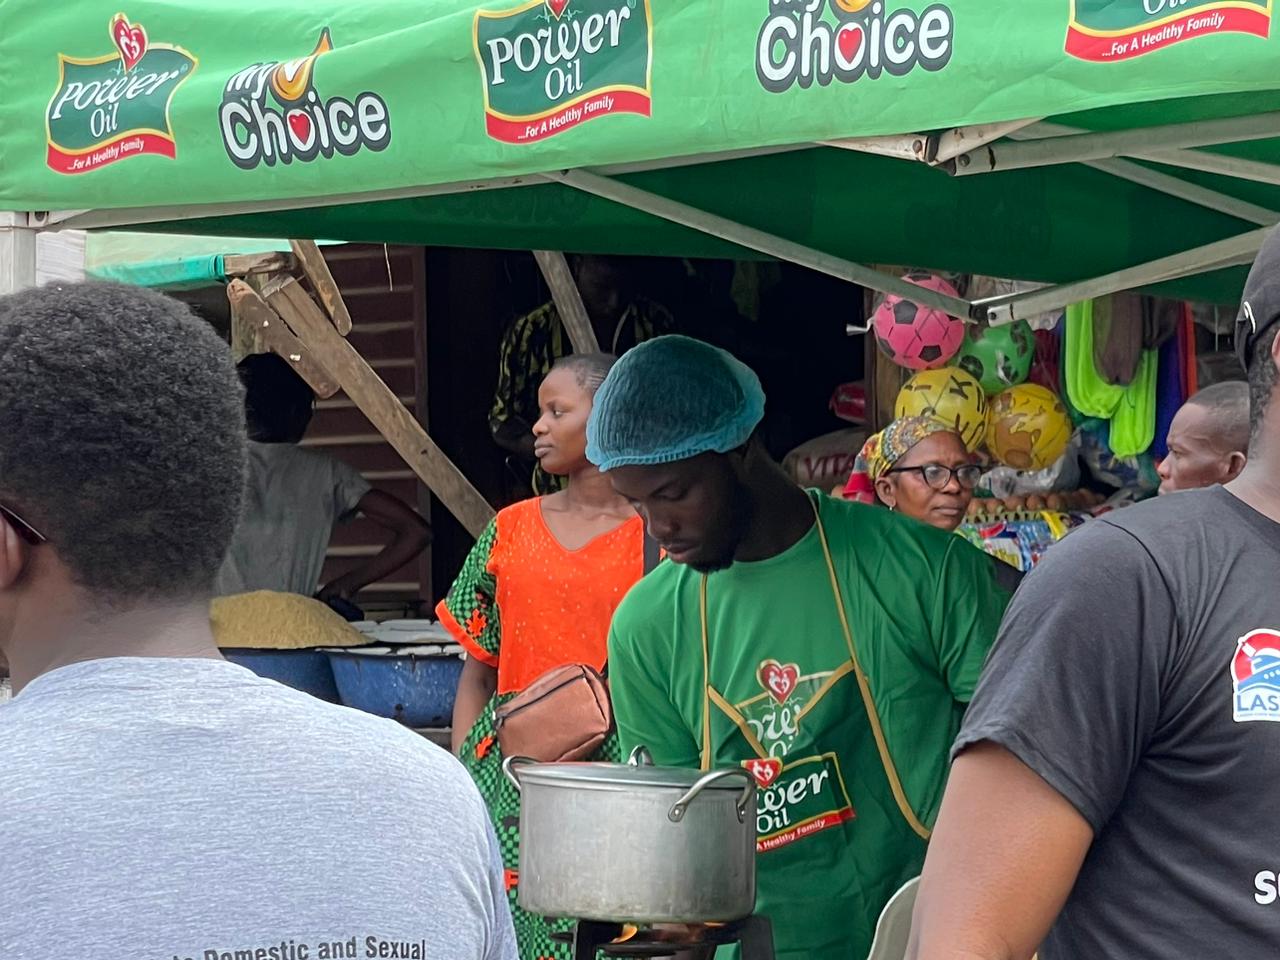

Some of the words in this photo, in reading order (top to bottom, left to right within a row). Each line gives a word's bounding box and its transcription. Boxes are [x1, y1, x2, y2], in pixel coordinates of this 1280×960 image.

[486, 6, 631, 85] Power
[758, 1, 951, 82] Choice
[1130, 41, 1139, 50] A
[1141, 24, 1184, 48] Healthy
[1186, 13, 1225, 32] Family
[51, 70, 179, 120] Power
[544, 59, 584, 100] Oil
[90, 102, 119, 138] Oil
[220, 90, 388, 160] Choice
[541, 123, 548, 133] A
[549, 107, 582, 130] Healthy
[584, 96, 614, 115] Family
[85, 155, 92, 166] A
[92, 147, 119, 165] Healthy
[120, 137, 145, 154] Family
[757, 769, 829, 814] wer
[757, 807, 792, 833] Oil
[763, 831, 796, 850] Healthy
[796, 818, 826, 835] Family
[317, 936, 358, 960] and
[365, 935, 427, 960] Sexual
